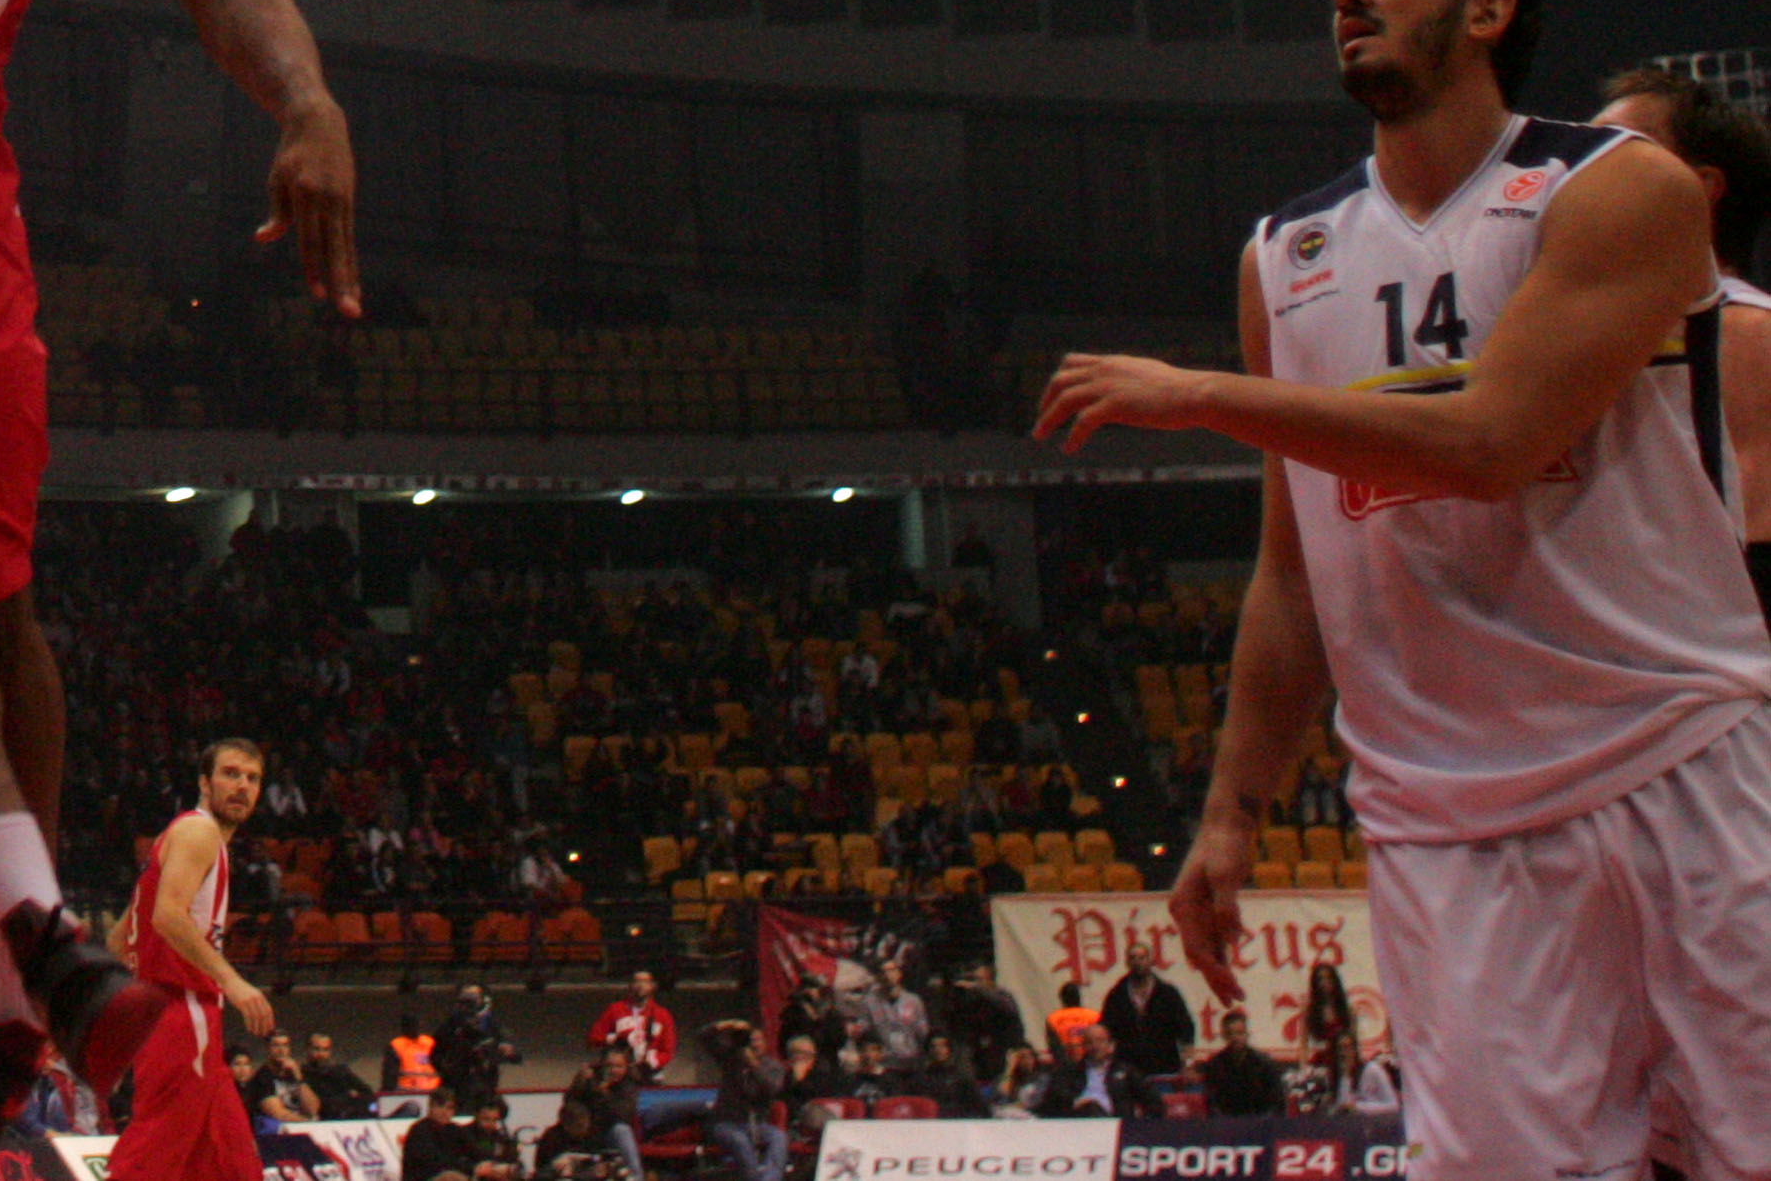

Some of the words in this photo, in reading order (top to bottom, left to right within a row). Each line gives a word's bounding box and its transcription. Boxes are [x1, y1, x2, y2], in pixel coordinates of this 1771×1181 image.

[1376, 271, 1469, 367] 14
[873, 1154, 1107, 1177] PEUGEOT
[1119, 1144, 1264, 1177] SPORT
[1274, 1144, 1336, 1177] 24
